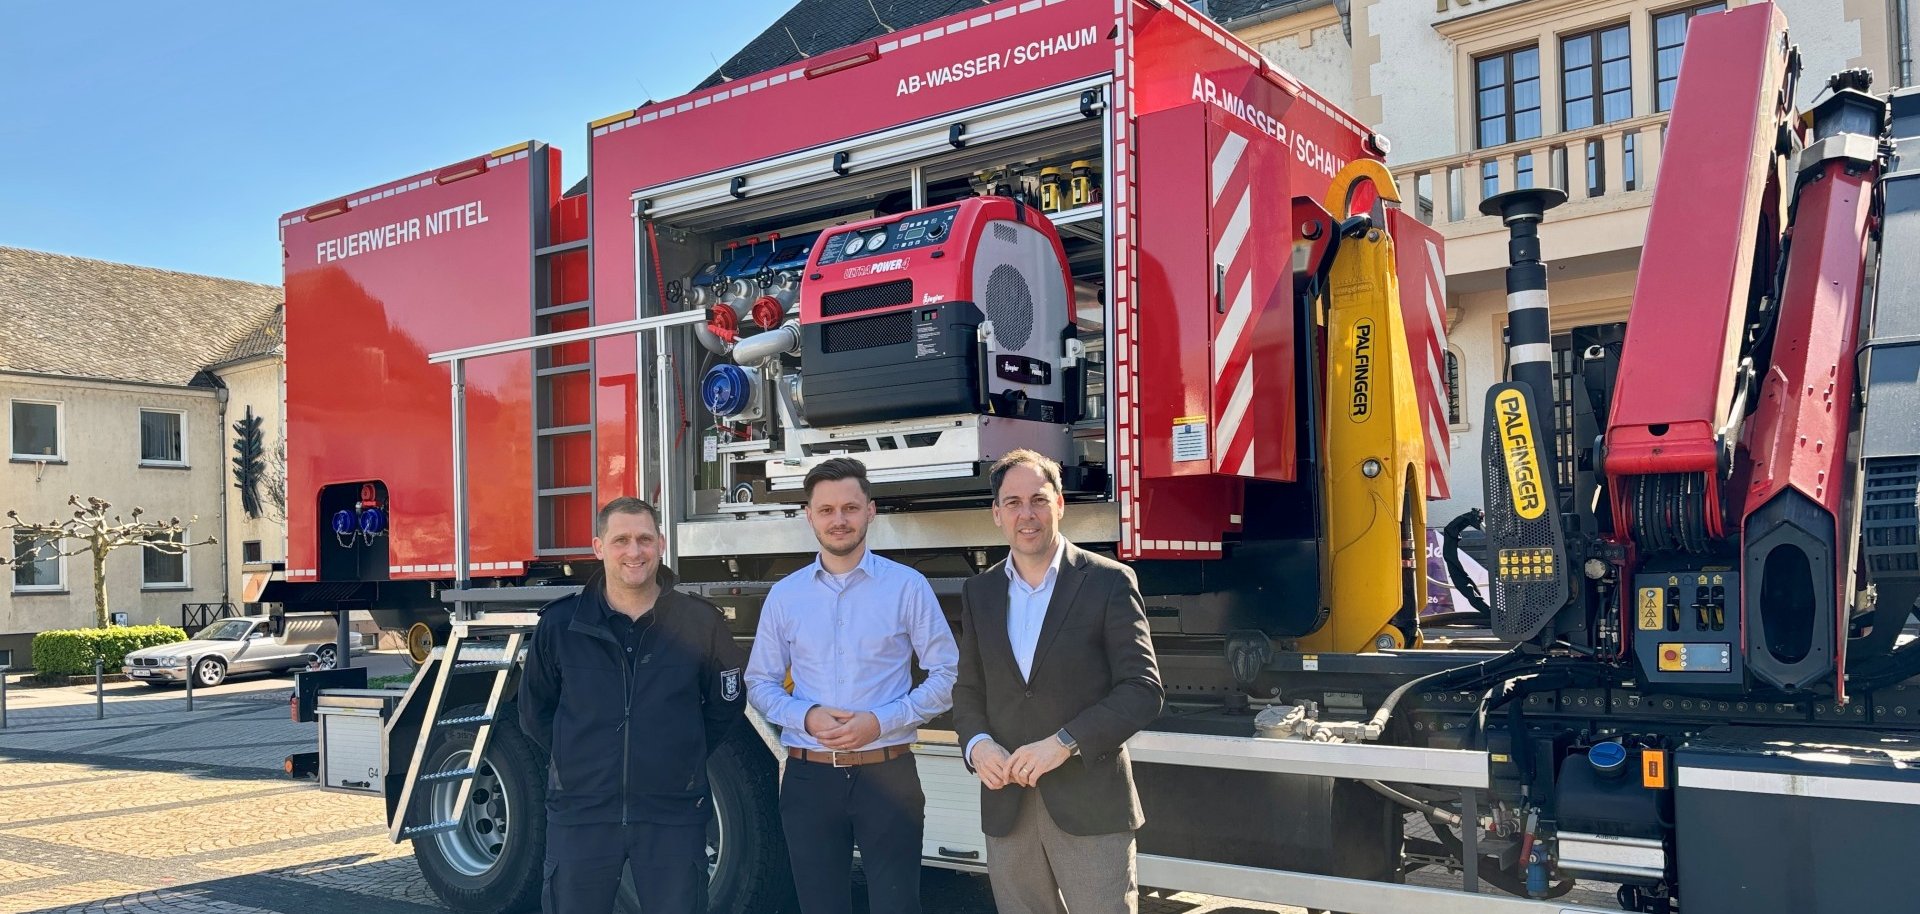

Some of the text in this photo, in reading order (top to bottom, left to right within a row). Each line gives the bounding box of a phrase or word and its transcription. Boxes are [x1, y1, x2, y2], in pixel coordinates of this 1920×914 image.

[896, 26, 1097, 97] AB-WASSER / SCHAUM
[316, 200, 489, 265] FEUERWEHR NITTEL
[1352, 324, 1371, 416] PALFINGER
[1500, 396, 1540, 512] PALFINGER
[367, 767, 379, 779] G4
